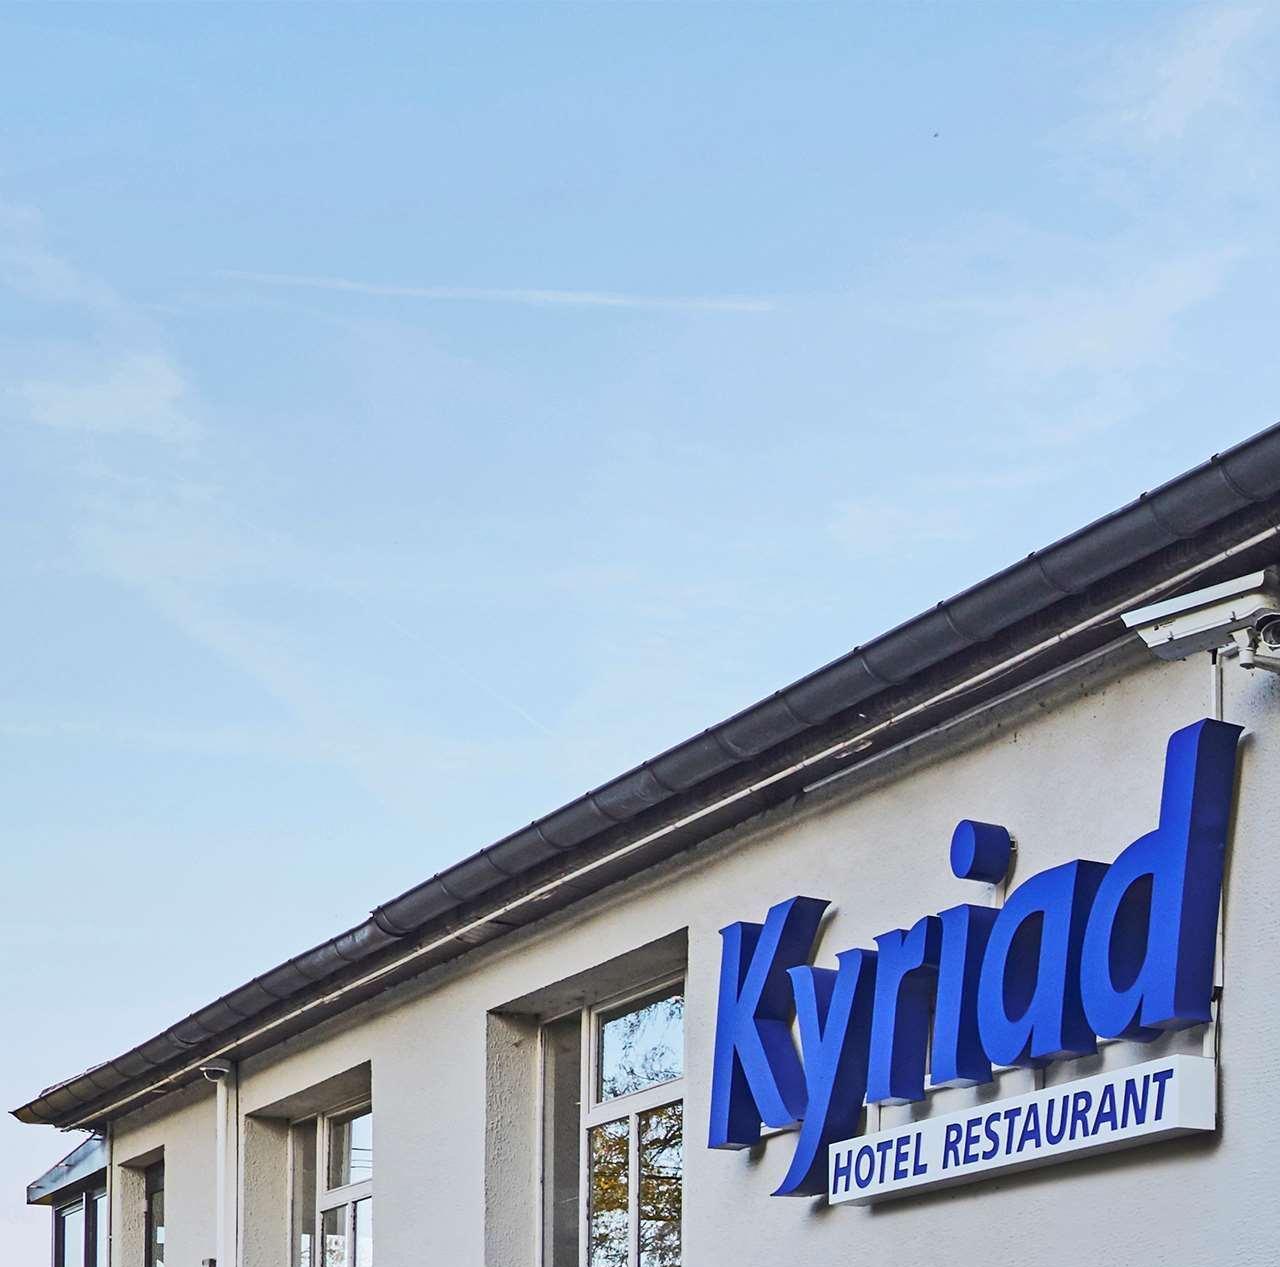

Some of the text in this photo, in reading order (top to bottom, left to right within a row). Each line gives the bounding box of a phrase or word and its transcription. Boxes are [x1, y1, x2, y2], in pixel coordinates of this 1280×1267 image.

[707, 718, 1244, 1196] Kyriad
[831, 1068, 1174, 1195] HOTEL RESTAURANT
